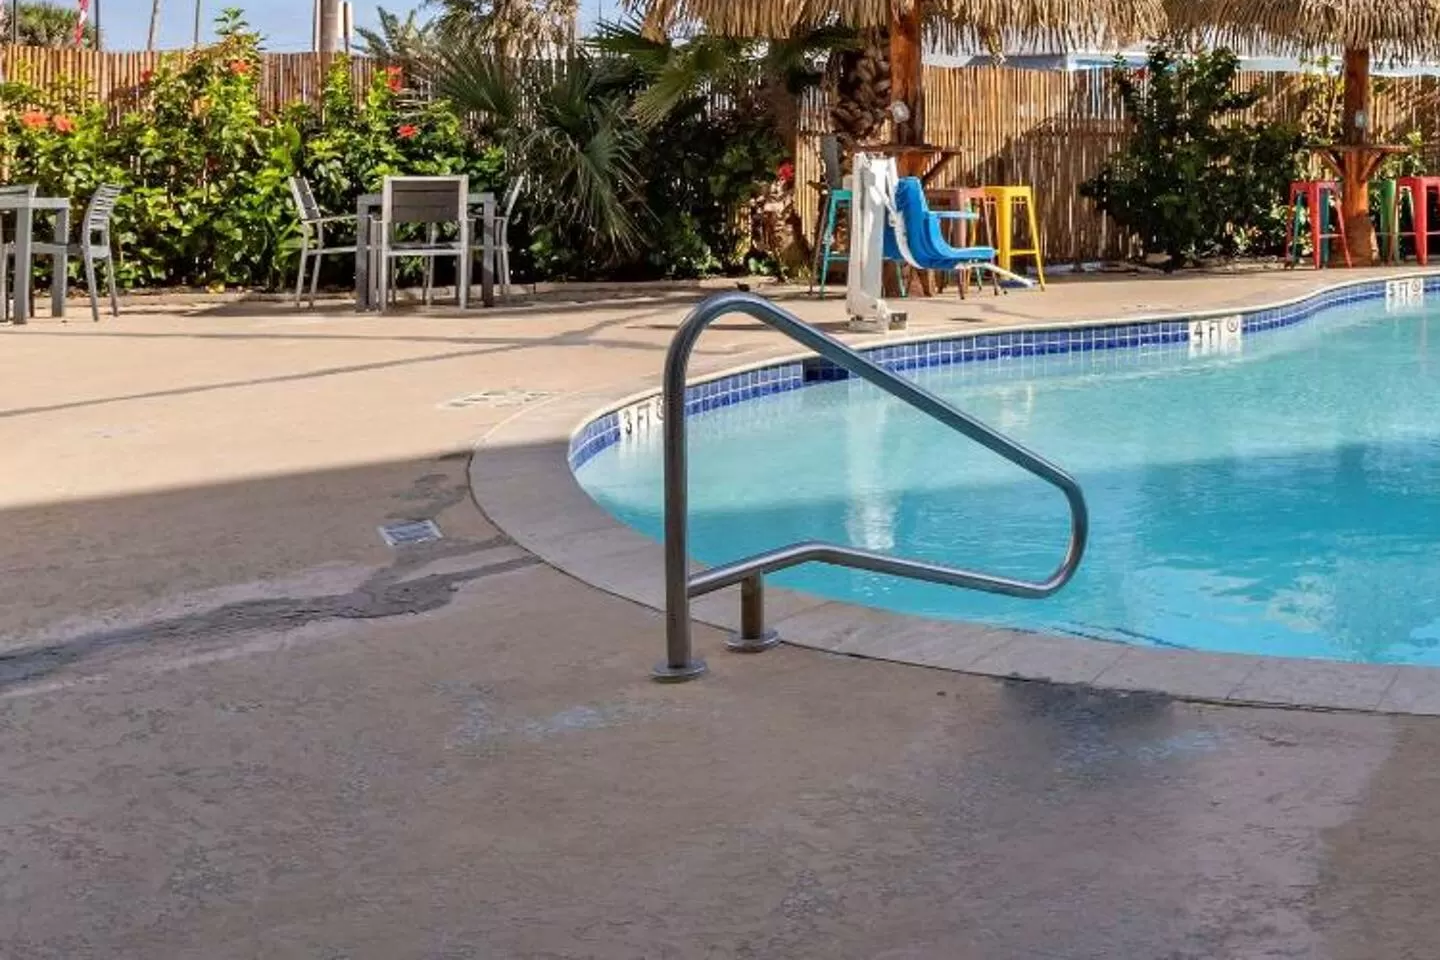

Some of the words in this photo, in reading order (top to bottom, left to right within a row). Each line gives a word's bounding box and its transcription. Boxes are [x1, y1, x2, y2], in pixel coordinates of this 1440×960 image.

[1194, 321, 1202, 339] 4
[1209, 320, 1221, 342] FT
[624, 409, 632, 435] 3
[637, 403, 650, 431] FT
